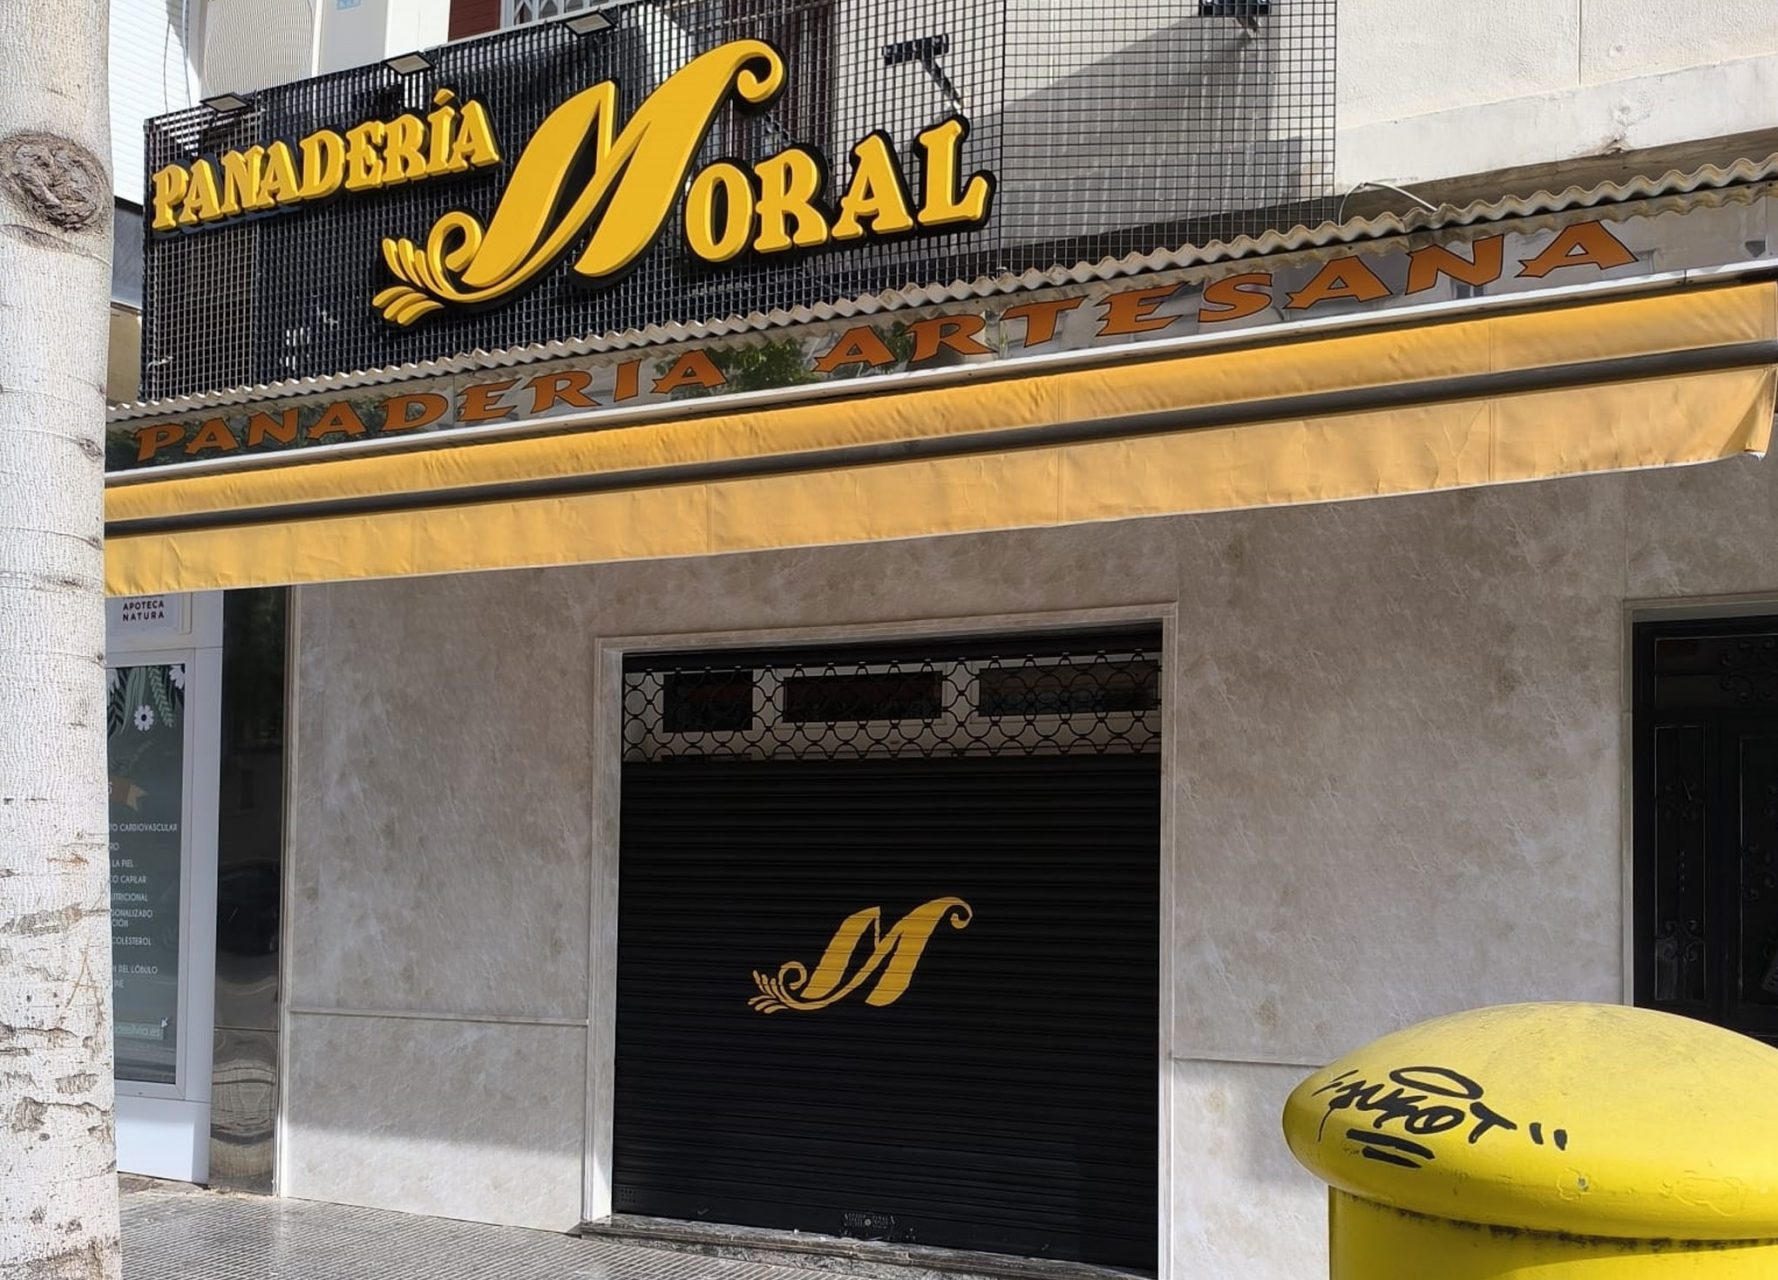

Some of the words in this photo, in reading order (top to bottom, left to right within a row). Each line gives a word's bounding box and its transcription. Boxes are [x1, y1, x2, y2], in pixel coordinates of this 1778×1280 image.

[152, 88, 500, 229] PANADERÍA
[134, 349, 729, 462] PANADERIA
[814, 219, 1639, 374] ARTESANA
[123, 600, 164, 610] APOTECA
[123, 611, 164, 621] NATURA
[120, 823, 178, 832] CARDIOVASCULAR
[121, 875, 147, 884] CAPILAR
[748, 896, 973, 1014] M
